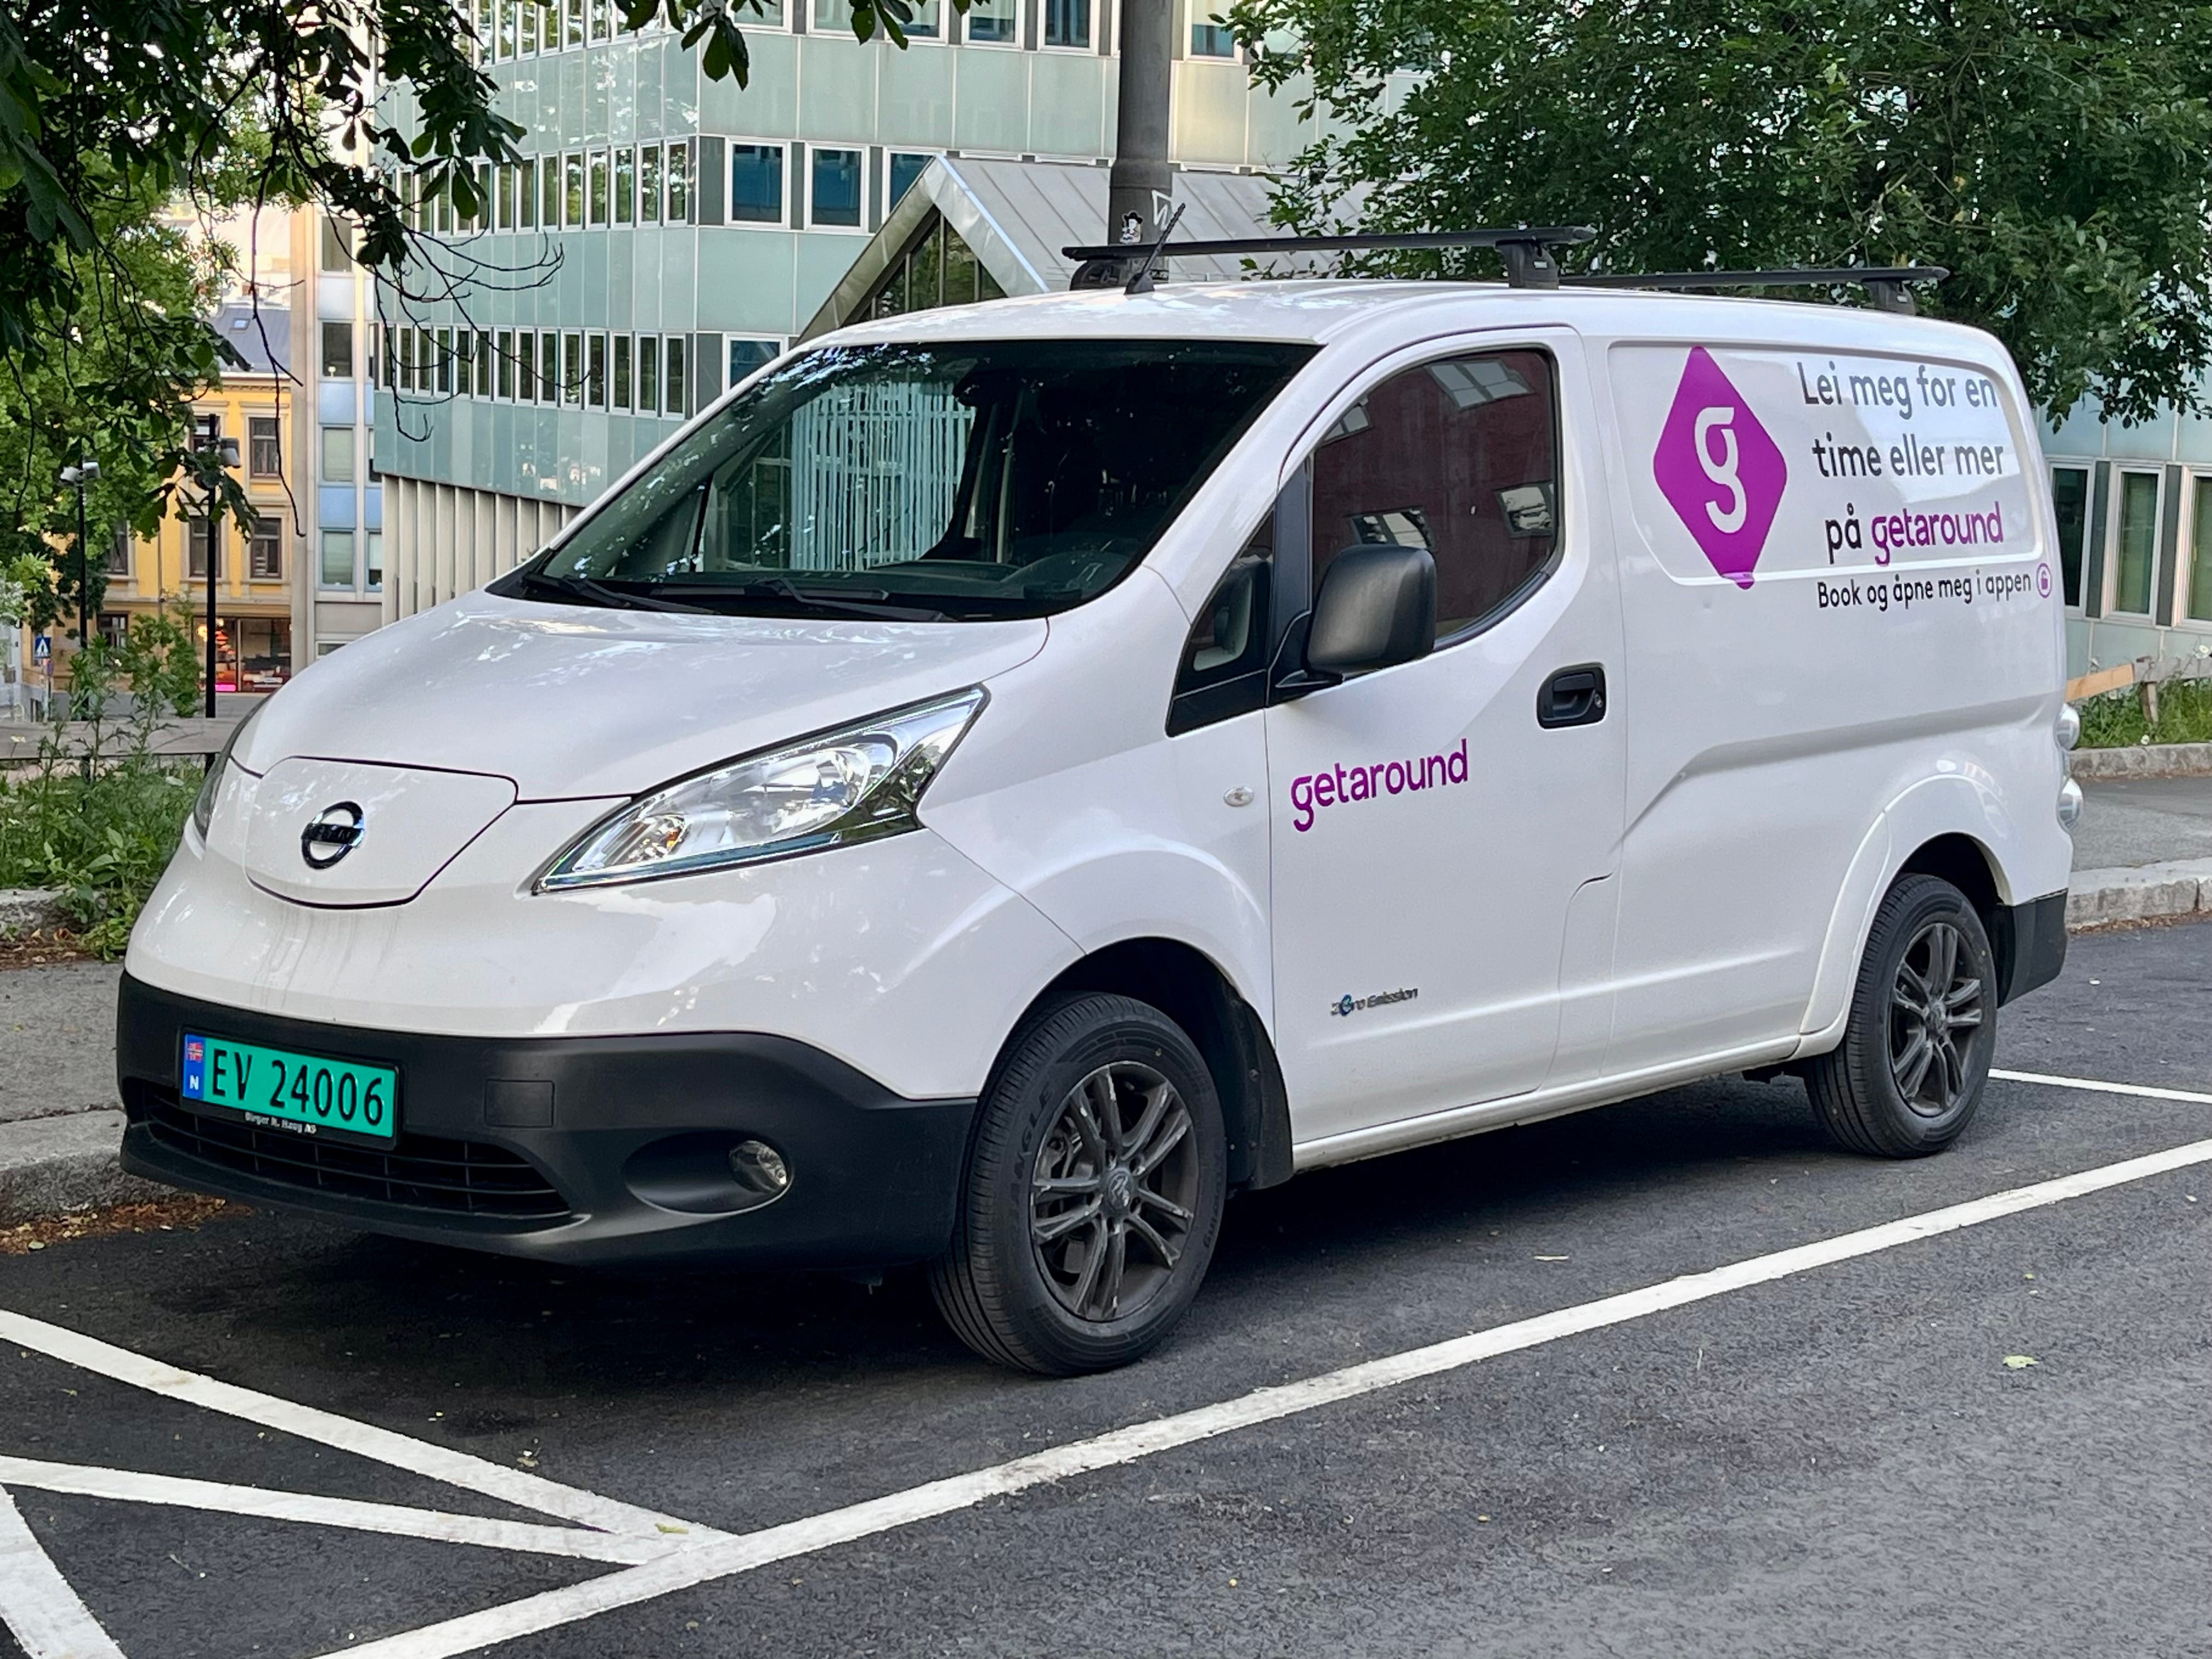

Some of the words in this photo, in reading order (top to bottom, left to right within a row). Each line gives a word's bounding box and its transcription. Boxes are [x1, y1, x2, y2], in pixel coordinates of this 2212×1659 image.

[1797, 361, 1842, 404] Lei
[1849, 374, 1912, 420] meg
[1916, 365, 1956, 407] for
[1966, 376, 1997, 407] en
[1812, 432, 1882, 477] time
[1890, 433, 1952, 476] eller
[1955, 444, 2004, 475] mer
[1825, 503, 1863, 565] på
[1871, 501, 2004, 566] getaround
[1818, 579, 1862, 608] Book
[1867, 584, 1888, 612] og
[1893, 574, 1933, 610] åpne
[1938, 577, 1973, 604] meg
[1976, 569, 1982, 595] i
[1985, 572, 2032, 601] appen
[1291, 738, 1468, 832] getaround
[189, 1075, 199, 1090] N
[212, 1048, 252, 1101] EV
[270, 1059, 384, 1126] 24006
